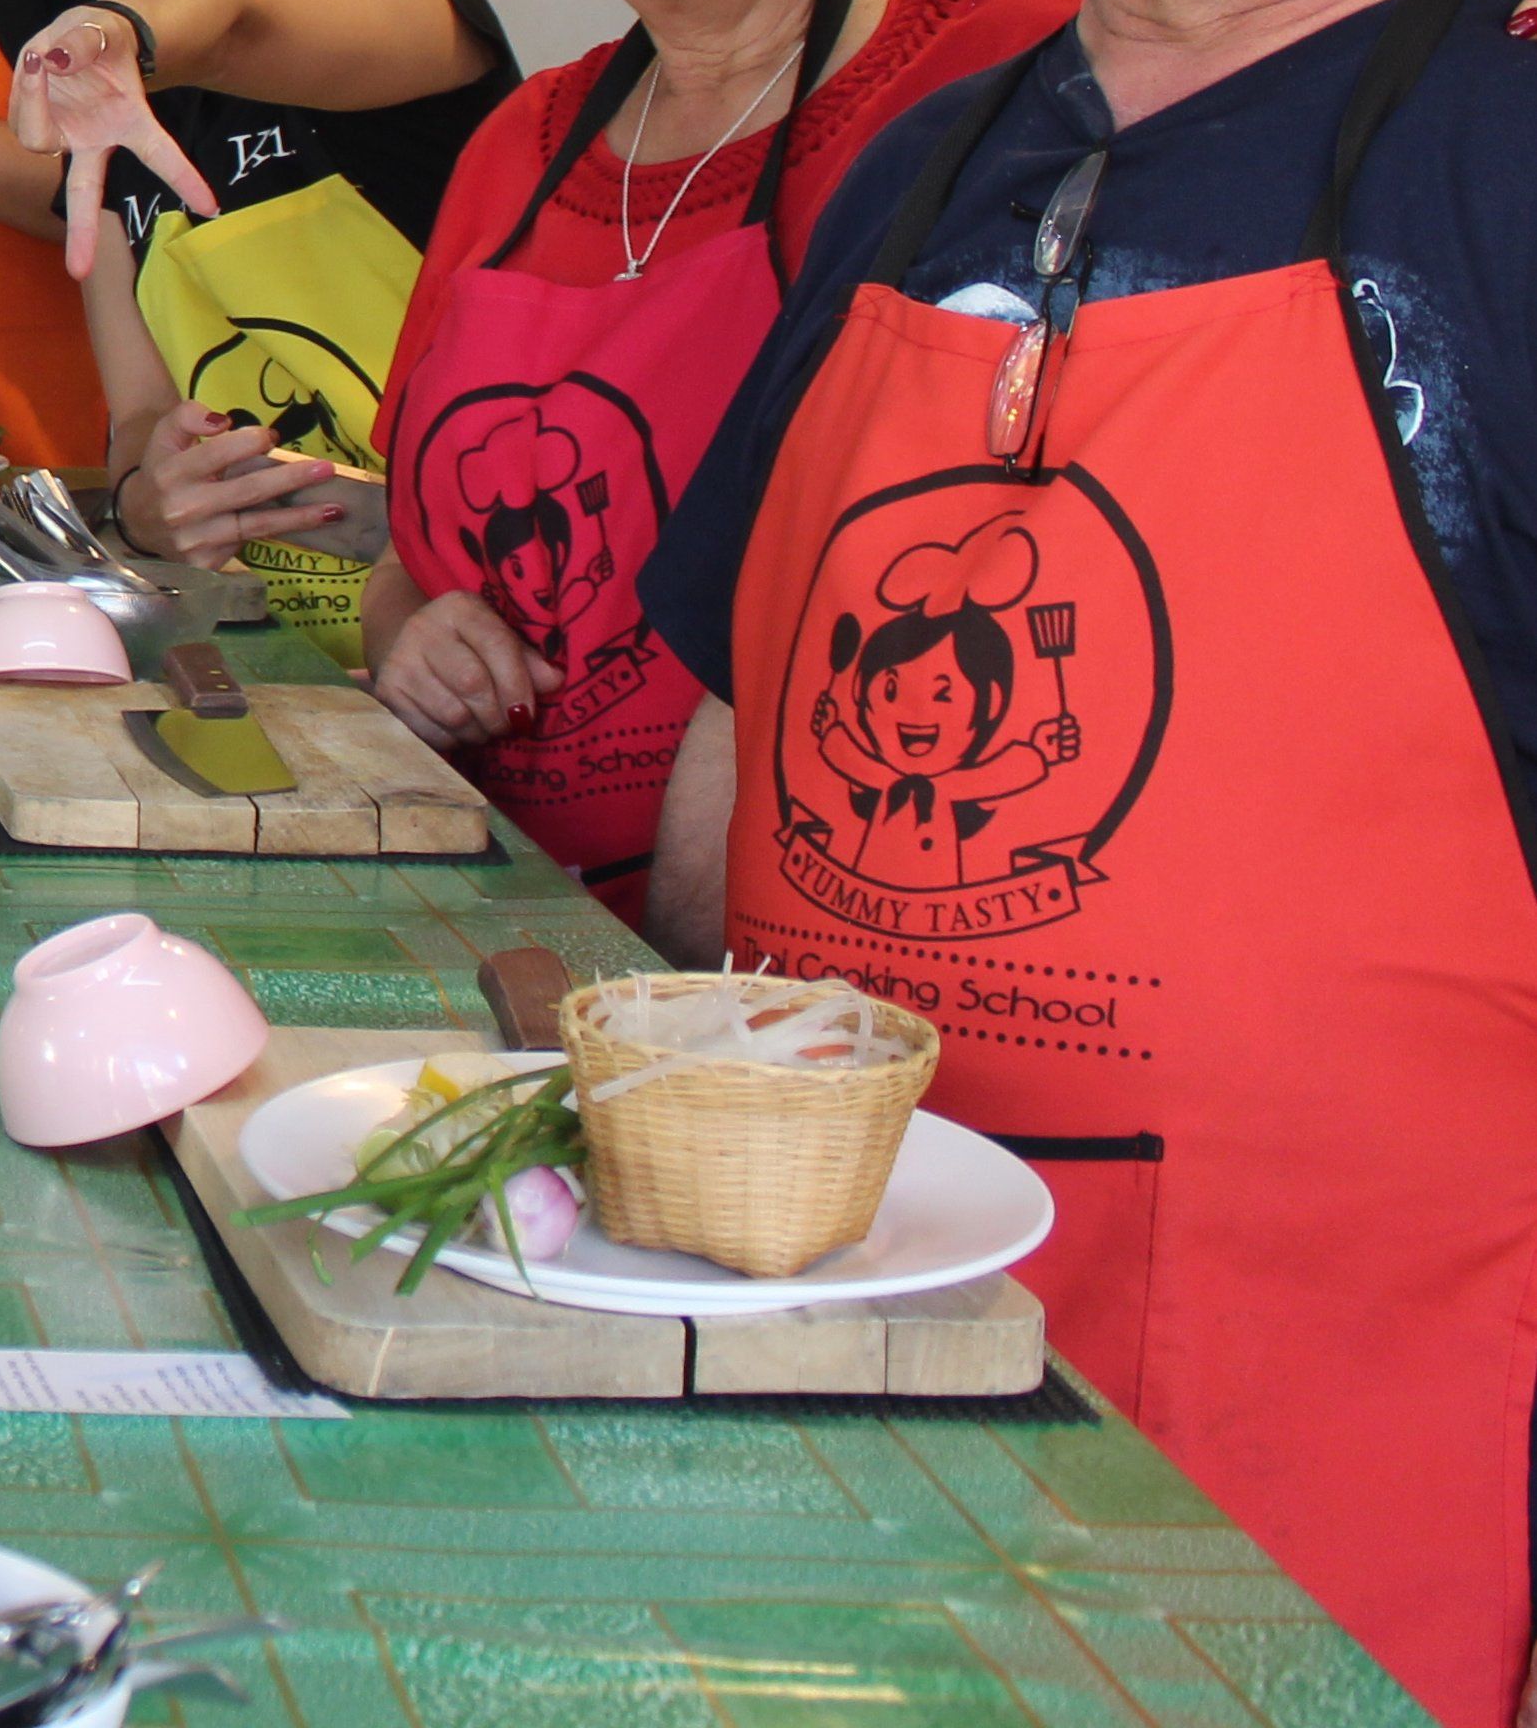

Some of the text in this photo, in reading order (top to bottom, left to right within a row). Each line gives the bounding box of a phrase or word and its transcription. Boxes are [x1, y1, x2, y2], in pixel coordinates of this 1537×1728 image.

[248, 541, 323, 570] UMMY
[268, 590, 351, 613] ooking
[557, 670, 620, 728] ASTY
[802, 851, 1046, 933] YUMMY TASTY
[956, 978, 1117, 1029] School
